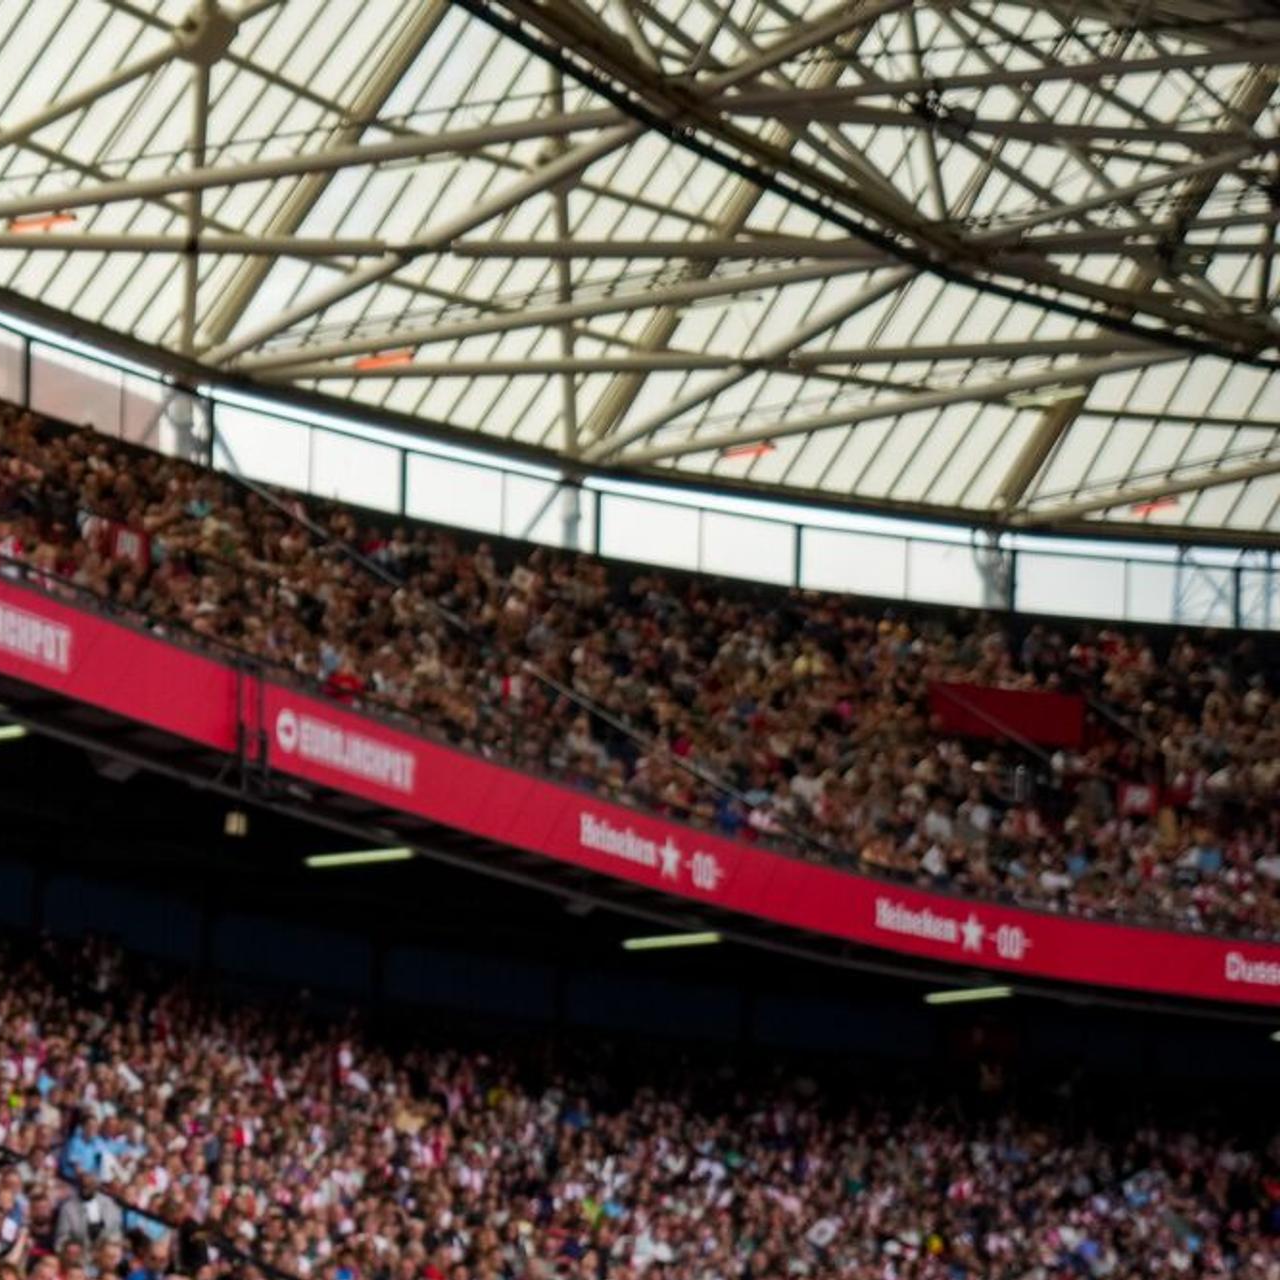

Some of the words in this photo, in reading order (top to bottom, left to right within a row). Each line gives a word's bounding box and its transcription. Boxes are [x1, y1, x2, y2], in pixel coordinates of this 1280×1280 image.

[297, 719, 416, 793] EUROJACKPOT
[580, 812, 659, 868] Heineken
[876, 899, 958, 944] Heineken
